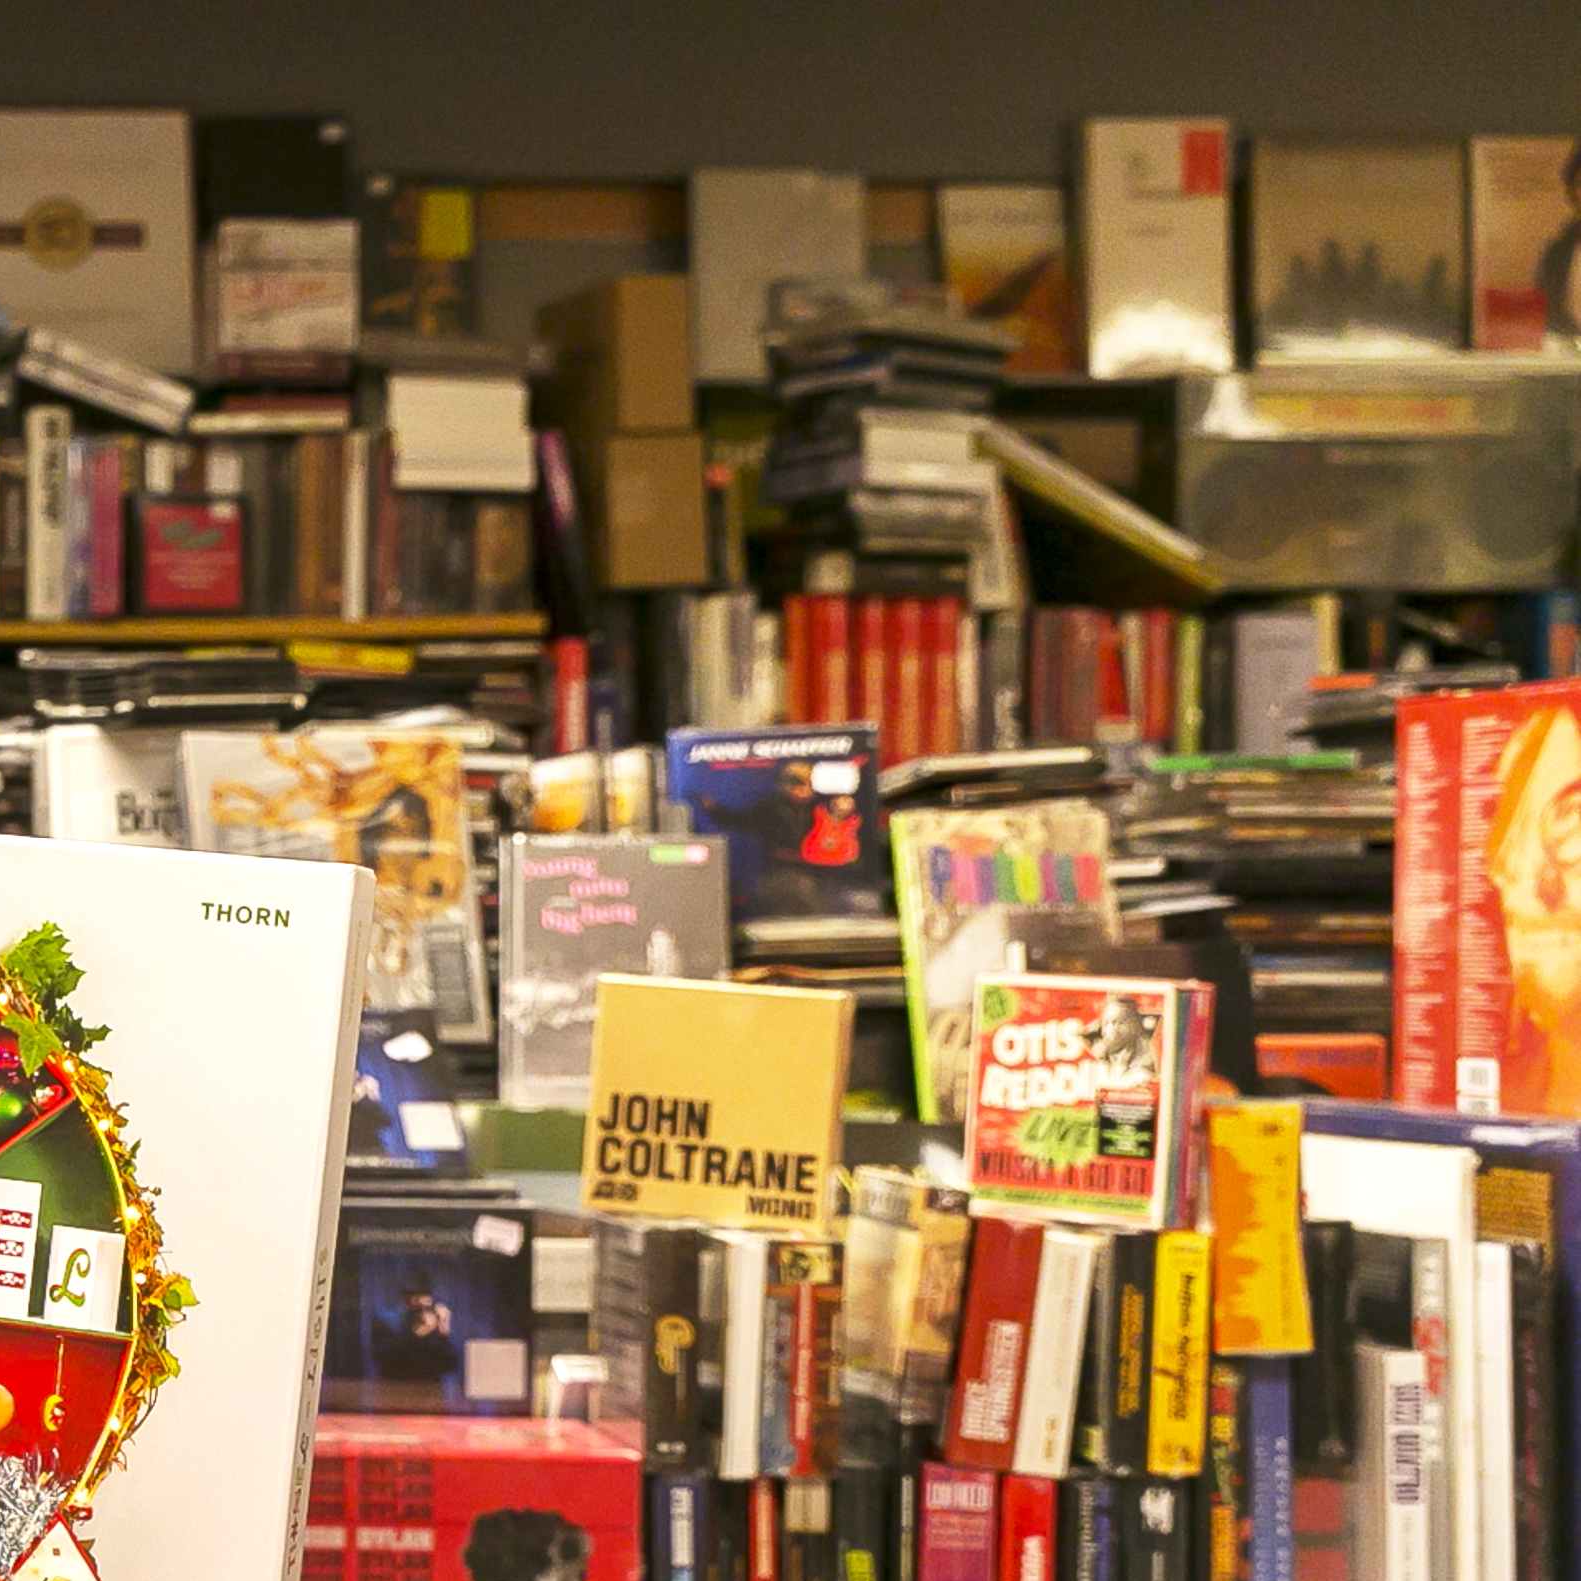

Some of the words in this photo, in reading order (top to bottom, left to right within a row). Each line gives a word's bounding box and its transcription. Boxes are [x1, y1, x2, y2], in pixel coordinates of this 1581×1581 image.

[200, 901, 291, 929] THORN
[992, 1017, 1085, 1067] OTIS
[597, 1092, 711, 1139] JOHN
[598, 1136, 817, 1194] COLTRANE
